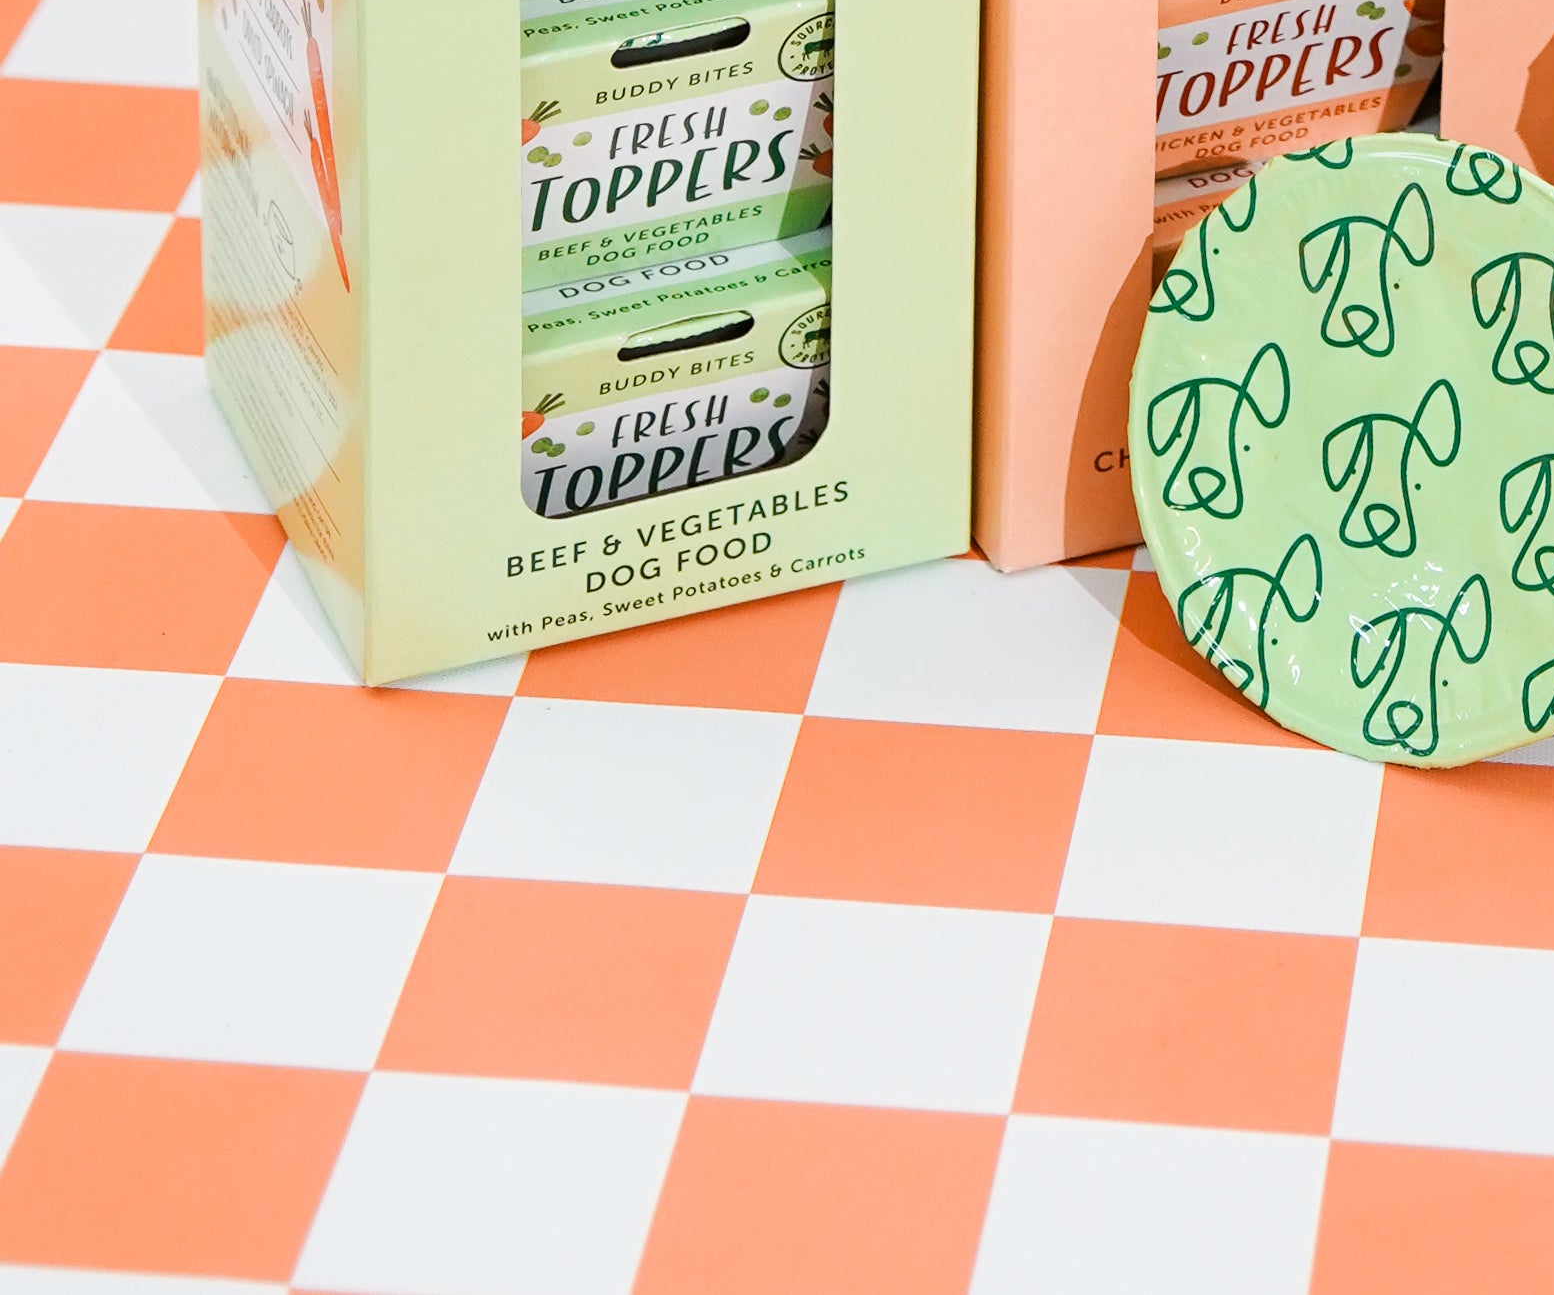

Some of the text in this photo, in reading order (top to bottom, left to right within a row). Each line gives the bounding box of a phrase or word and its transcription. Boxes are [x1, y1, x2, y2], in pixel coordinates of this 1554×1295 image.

[524, 19, 579, 38] Peas,
[585, 8, 650, 27] Sweet
[790, 17, 834, 46] SOURC
[1226, 4, 1337, 55] FRESH
[595, 61, 755, 105] BUDDY BITES
[792, 60, 834, 76] PROTE
[1156, 27, 1394, 123] TOPPERS
[609, 106, 727, 160] FRESH
[1232, 125, 1244, 137] &
[1254, 96, 1384, 132] VEGETABLES
[1195, 127, 1309, 159] DOG FOOD
[530, 129, 795, 232] TOPPERS
[1187, 167, 1254, 188] DOG
[538, 205, 763, 261] BEEF & VEGETABLES
[586, 232, 710, 266] DOG FOOD
[527, 258, 832, 333] Peas, Sweet Potatoes & Carro
[558, 254, 730, 299] DOG FOOD
[599, 350, 755, 396] BUDDY BITES
[611, 394, 729, 449] FRESH
[534, 415, 795, 516] TOPPERS
[507, 480, 850, 577] BEEF & VEGETABLES
[586, 531, 773, 594] DOG FOOD
[487, 547, 866, 643] with Peas, Sweet Potatoes & Carrots
